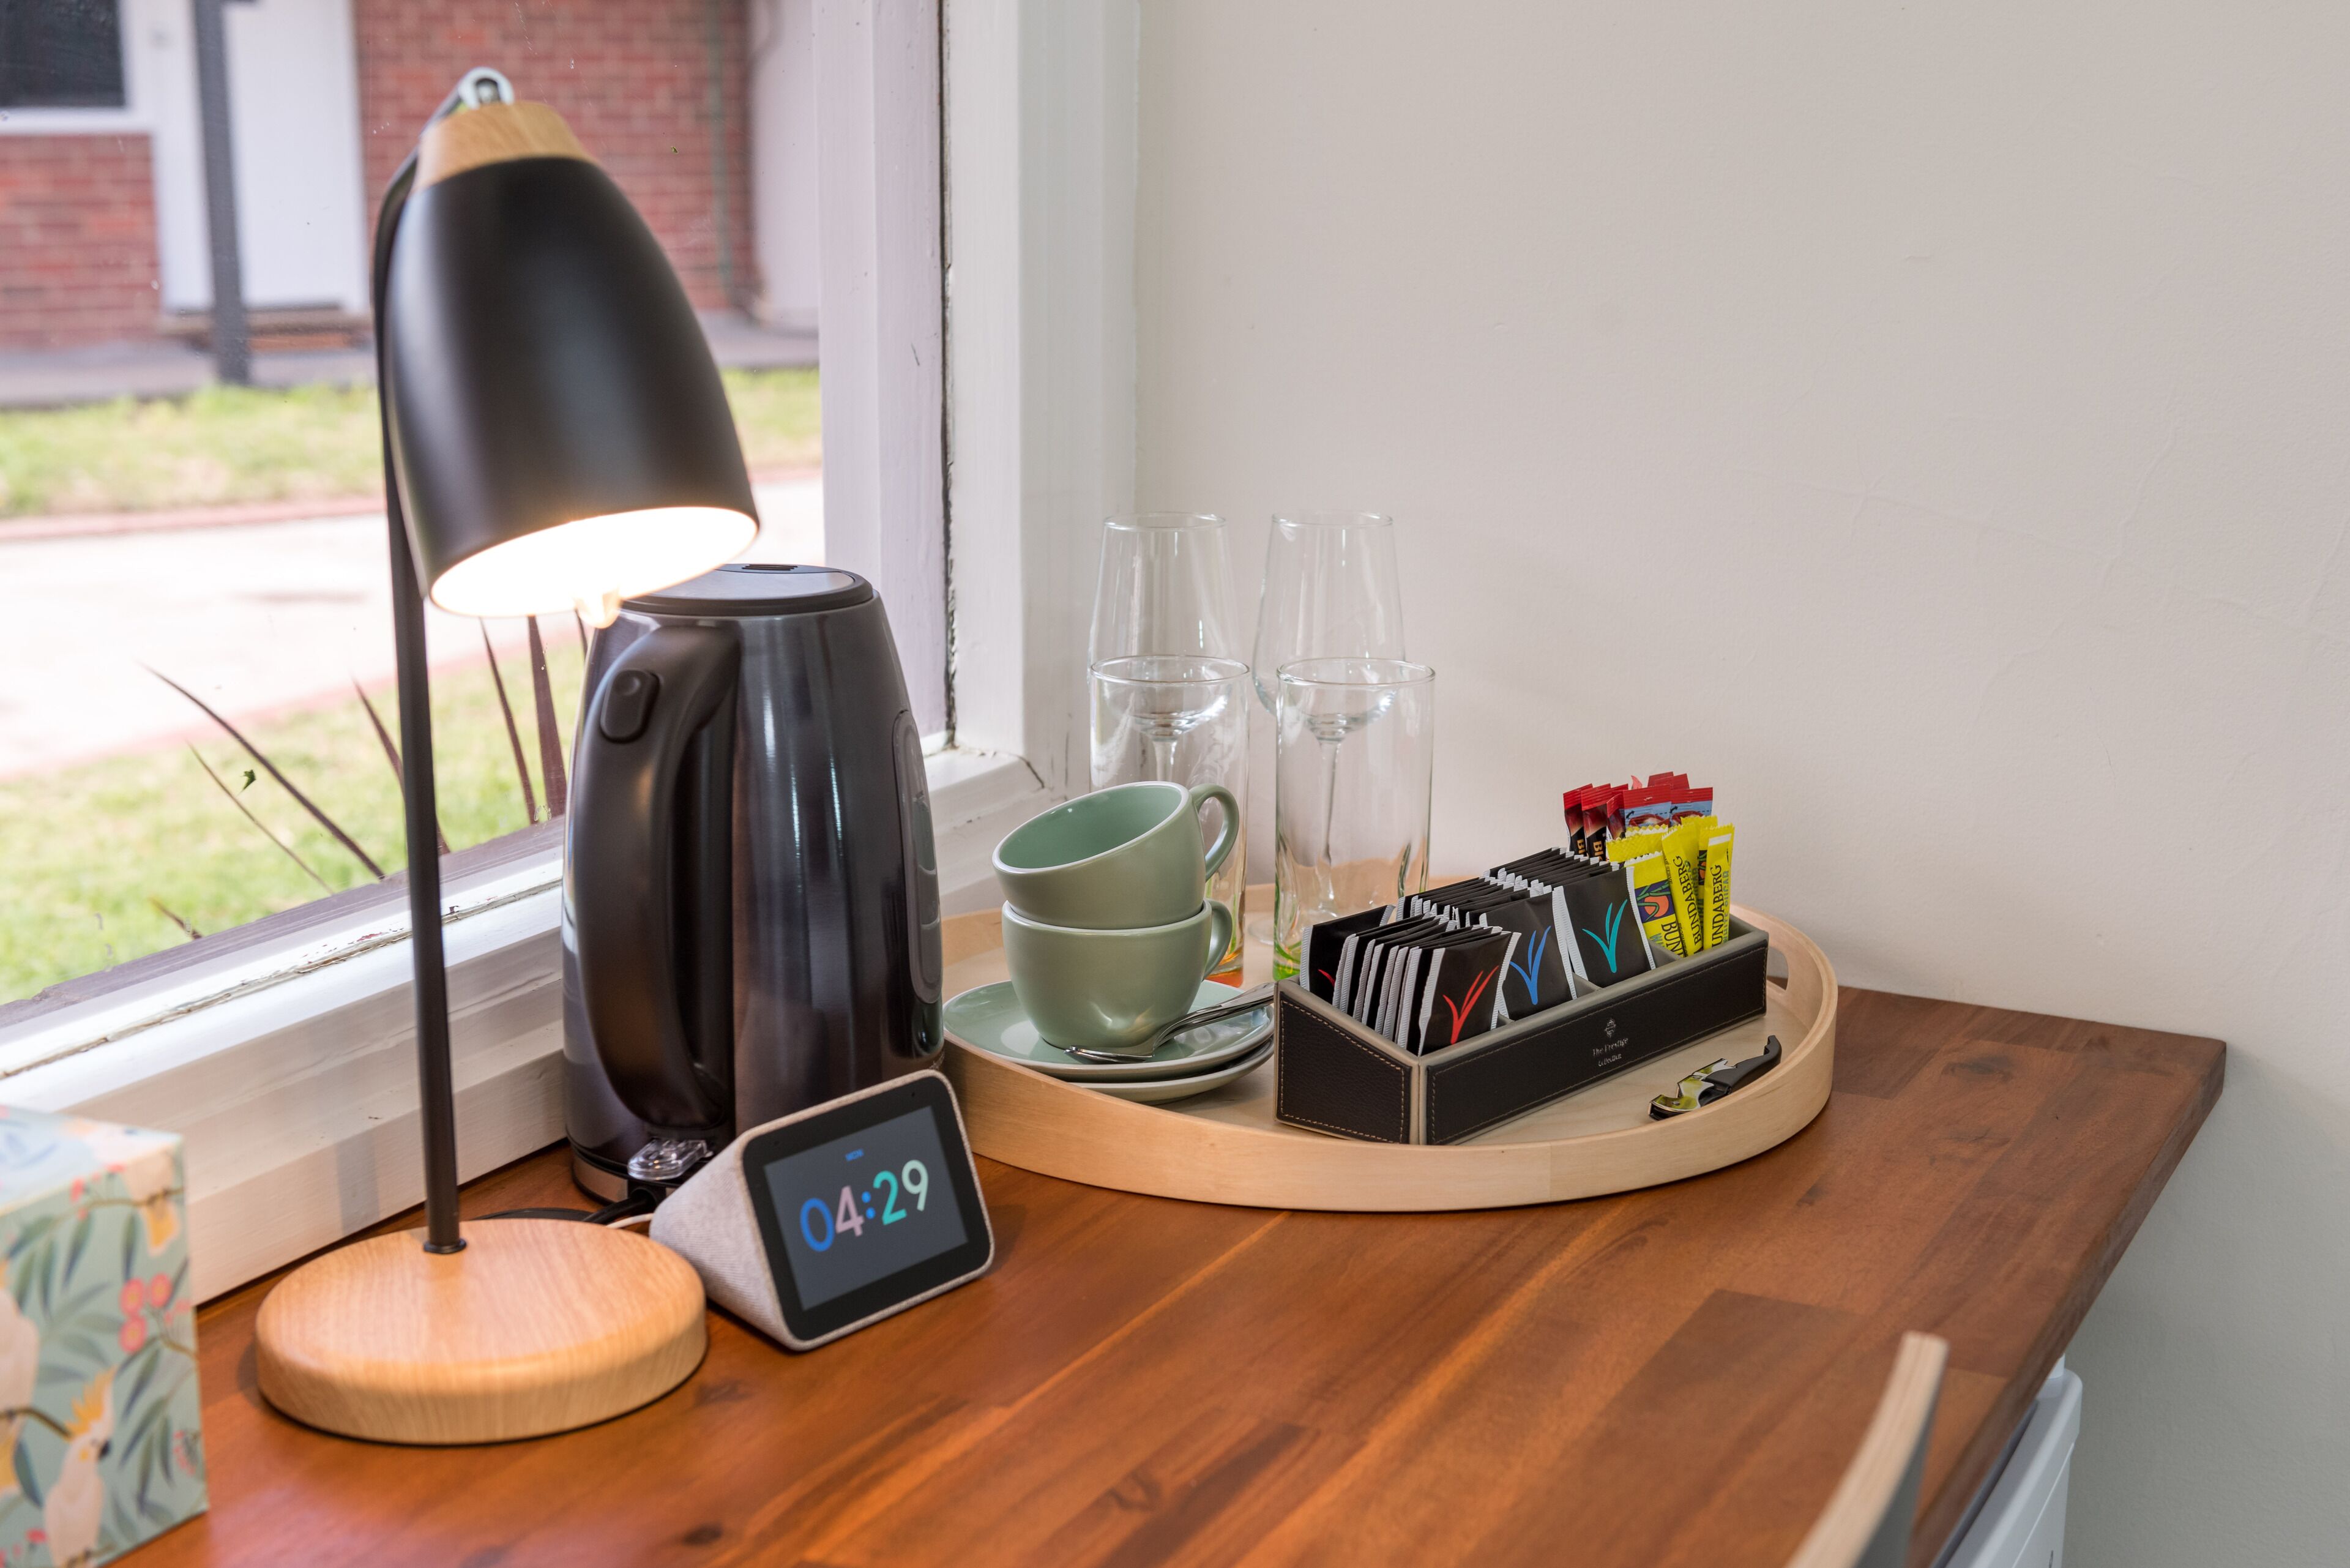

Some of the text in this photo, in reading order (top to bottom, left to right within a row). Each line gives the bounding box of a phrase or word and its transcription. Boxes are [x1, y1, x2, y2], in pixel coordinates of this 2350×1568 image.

[1661, 920, 1683, 956] BUN
[1673, 856, 1701, 946] BUNDABERG
[1710, 864, 1725, 947] UNDABERG
[800, 1159, 929, 1252] 04:29
